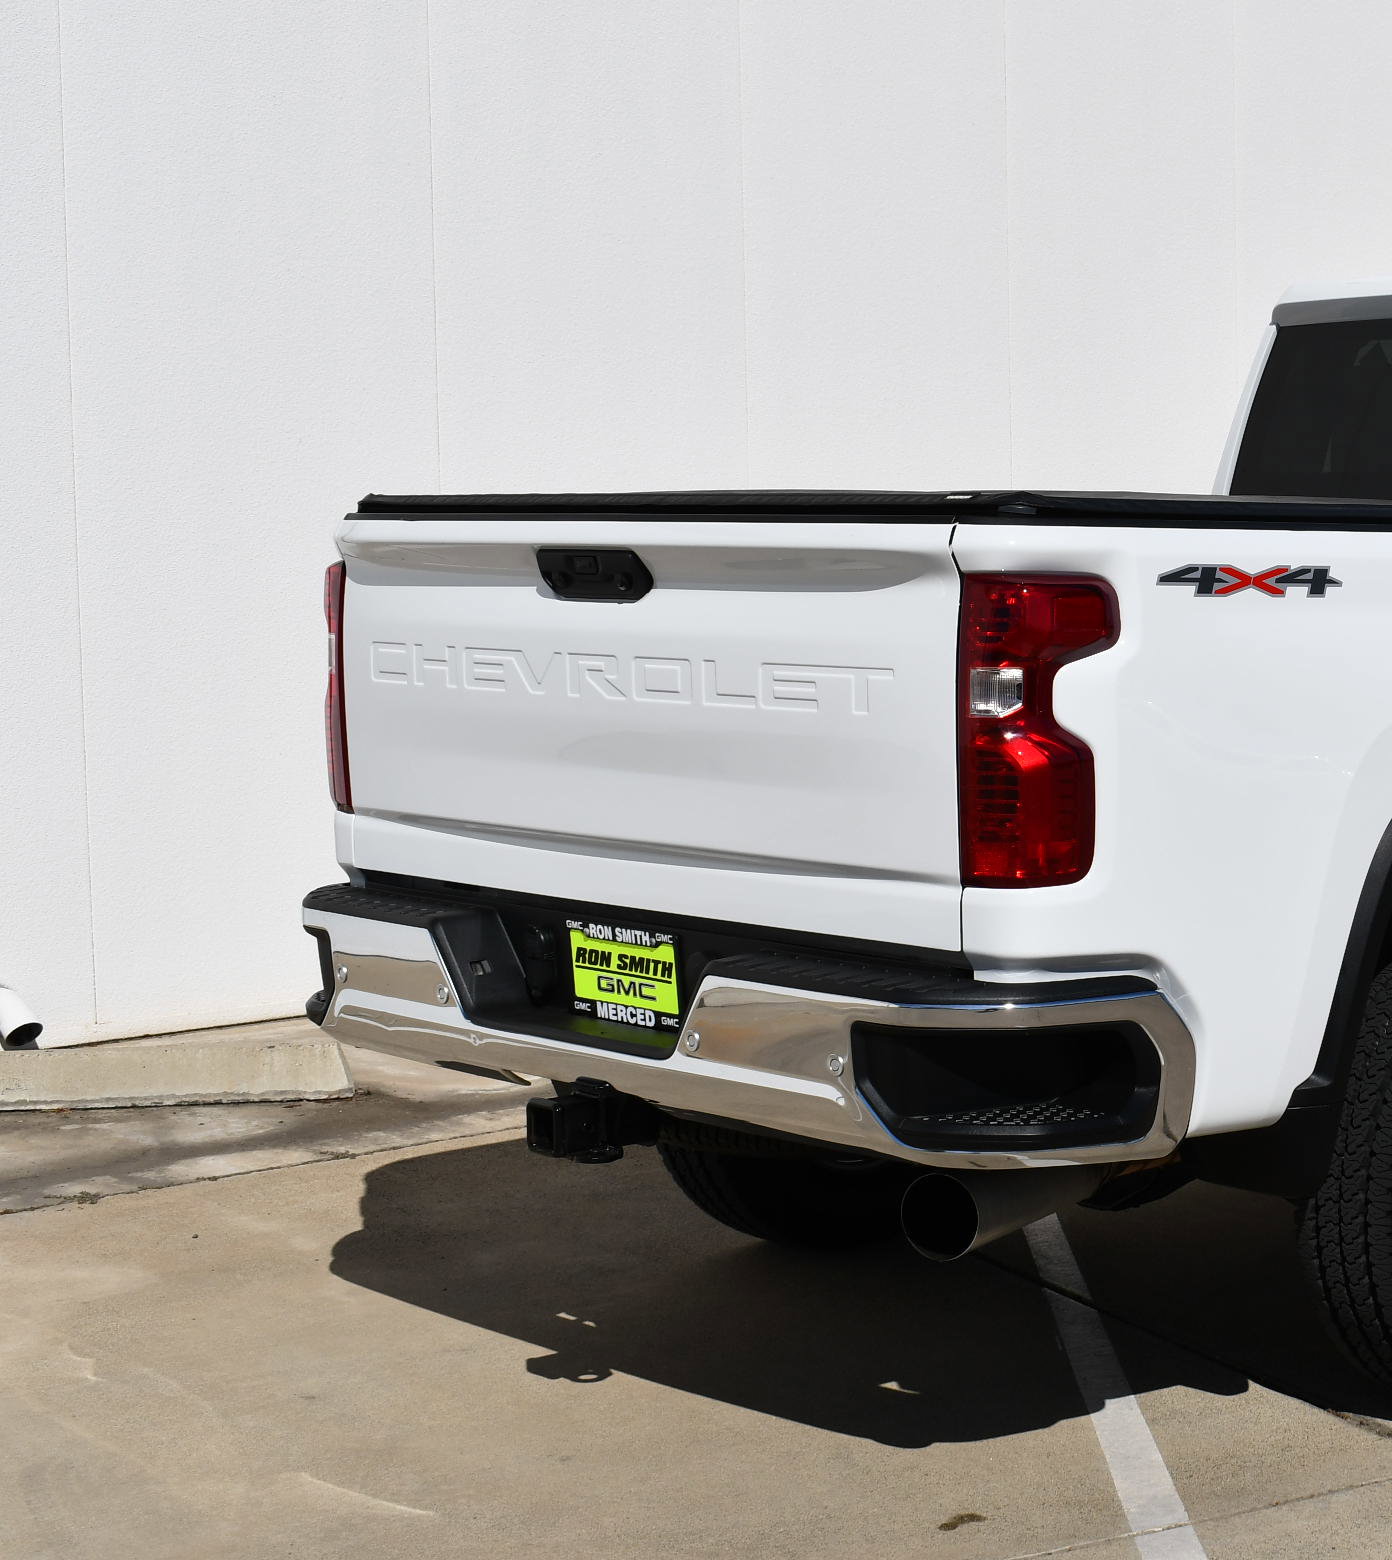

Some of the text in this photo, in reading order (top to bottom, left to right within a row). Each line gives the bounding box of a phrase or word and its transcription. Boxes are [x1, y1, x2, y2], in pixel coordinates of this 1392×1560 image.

[370, 640, 895, 715] CHEVROLET
[566, 919, 673, 946] GMC RON SMITH GMC
[575, 946, 673, 979] RON SMITH
[597, 975, 657, 1002] GMC
[574, 1001, 679, 1027] GMC MERCED GMC
